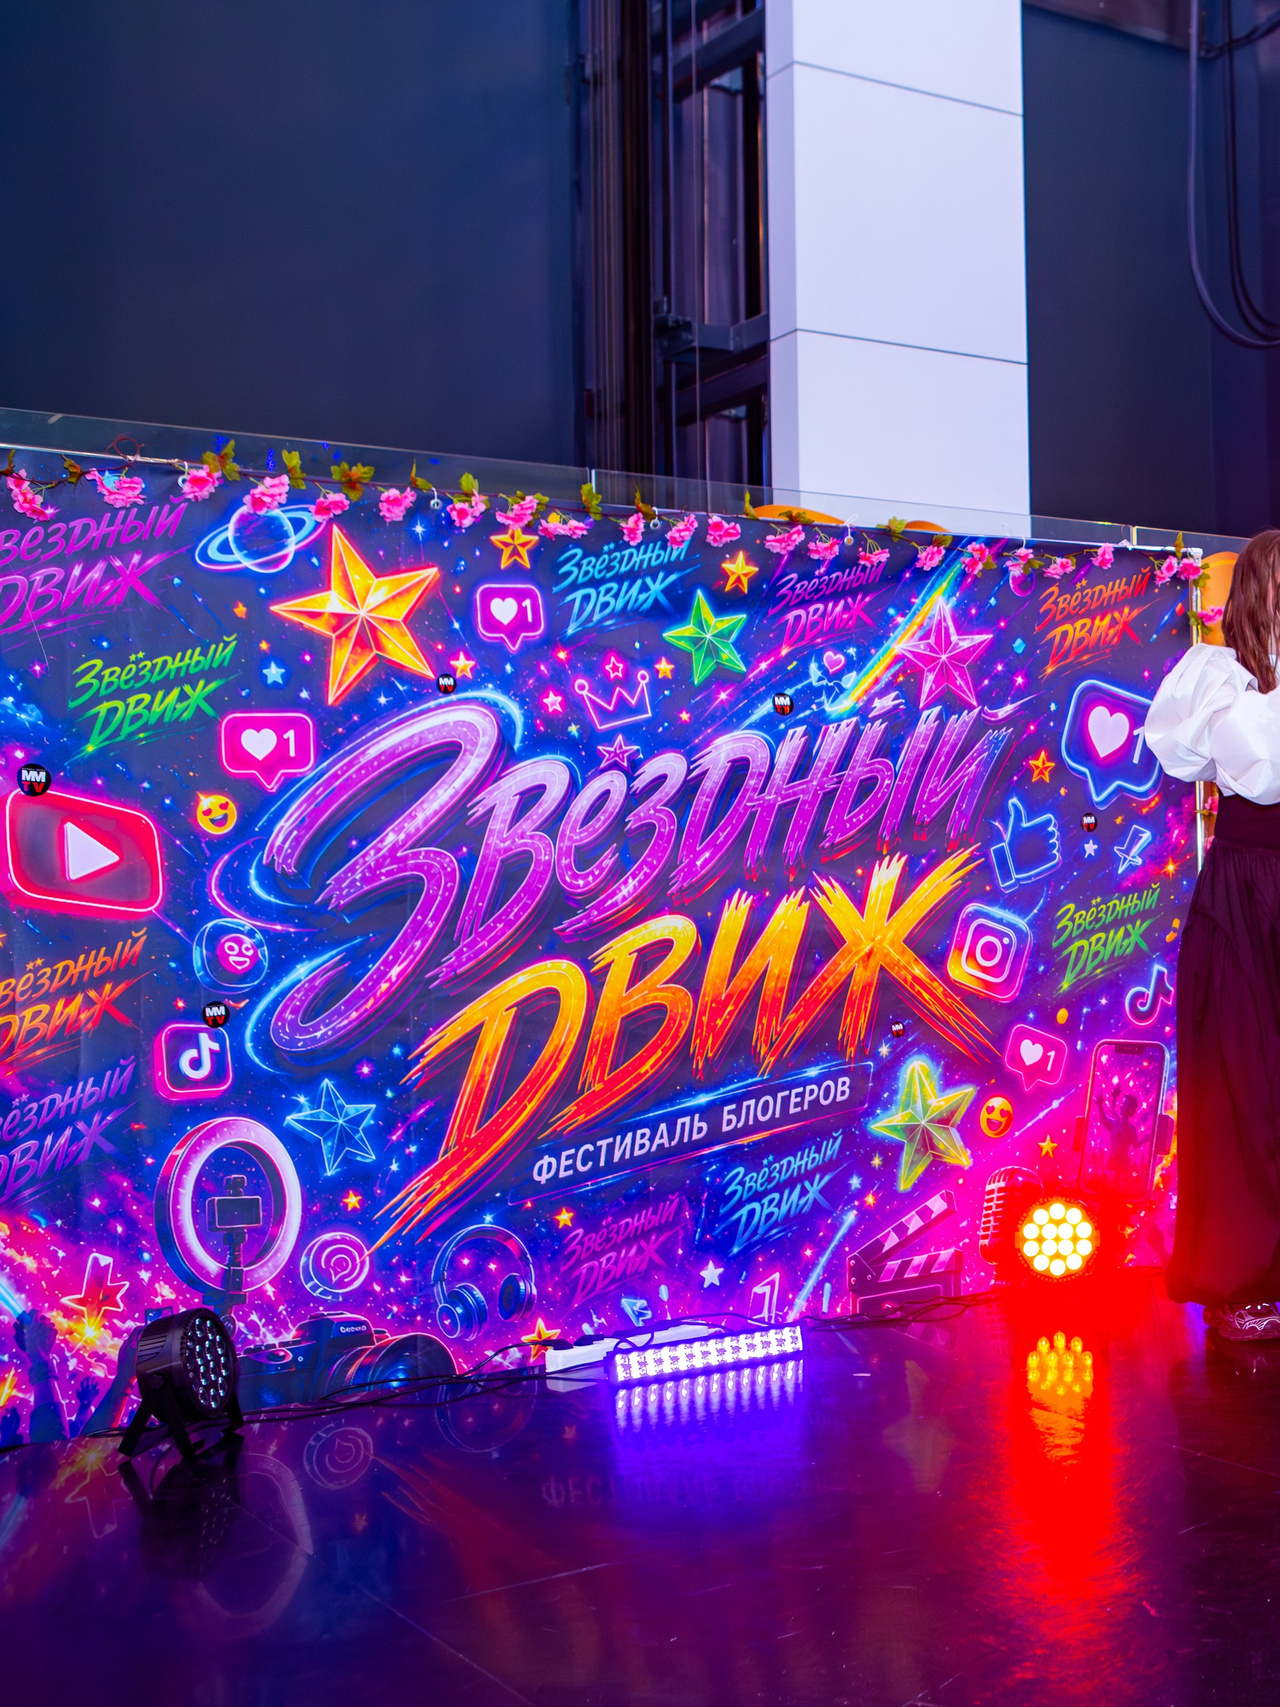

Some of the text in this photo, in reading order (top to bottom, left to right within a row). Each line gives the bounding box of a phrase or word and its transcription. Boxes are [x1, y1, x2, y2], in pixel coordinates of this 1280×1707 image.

[521, 598, 532, 623] 1
[283, 729, 296, 758] 1
[21, 769, 47, 783] MM
[21, 780, 46, 793] TV
[0, 926, 148, 1008] вёздный
[531, 1075, 851, 1186] ФЕСТИВАЛЬ БЛОГЕРОВ
[0, 1103, 134, 1198] ВИЖ
